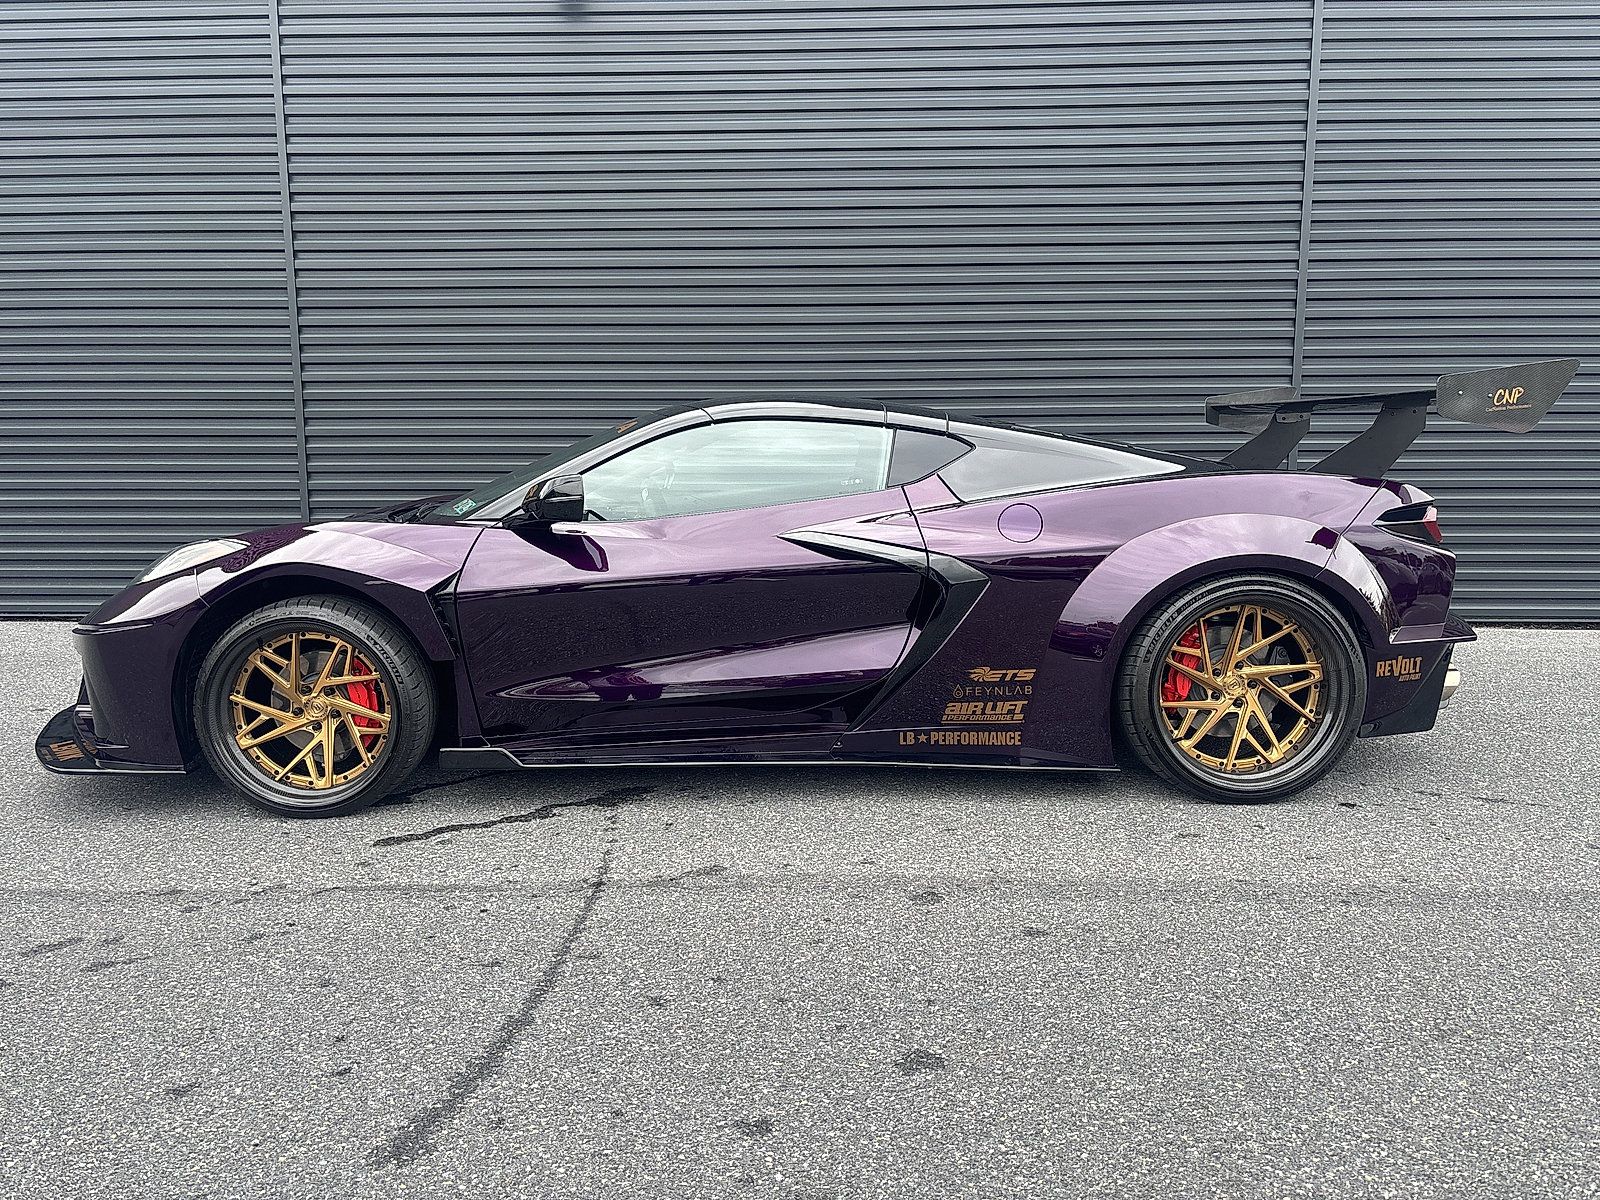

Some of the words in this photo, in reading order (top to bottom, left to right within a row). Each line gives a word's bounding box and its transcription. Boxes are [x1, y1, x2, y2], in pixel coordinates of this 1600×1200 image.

[1493, 386, 1525, 406] CNP
[1148, 611, 1178, 654] MICHELIN
[965, 685, 1033, 696] FEYNLAB
[984, 700, 1029, 715] LIFT
[899, 731, 915, 745] LB
[930, 731, 1022, 746] PERFORMANCE
